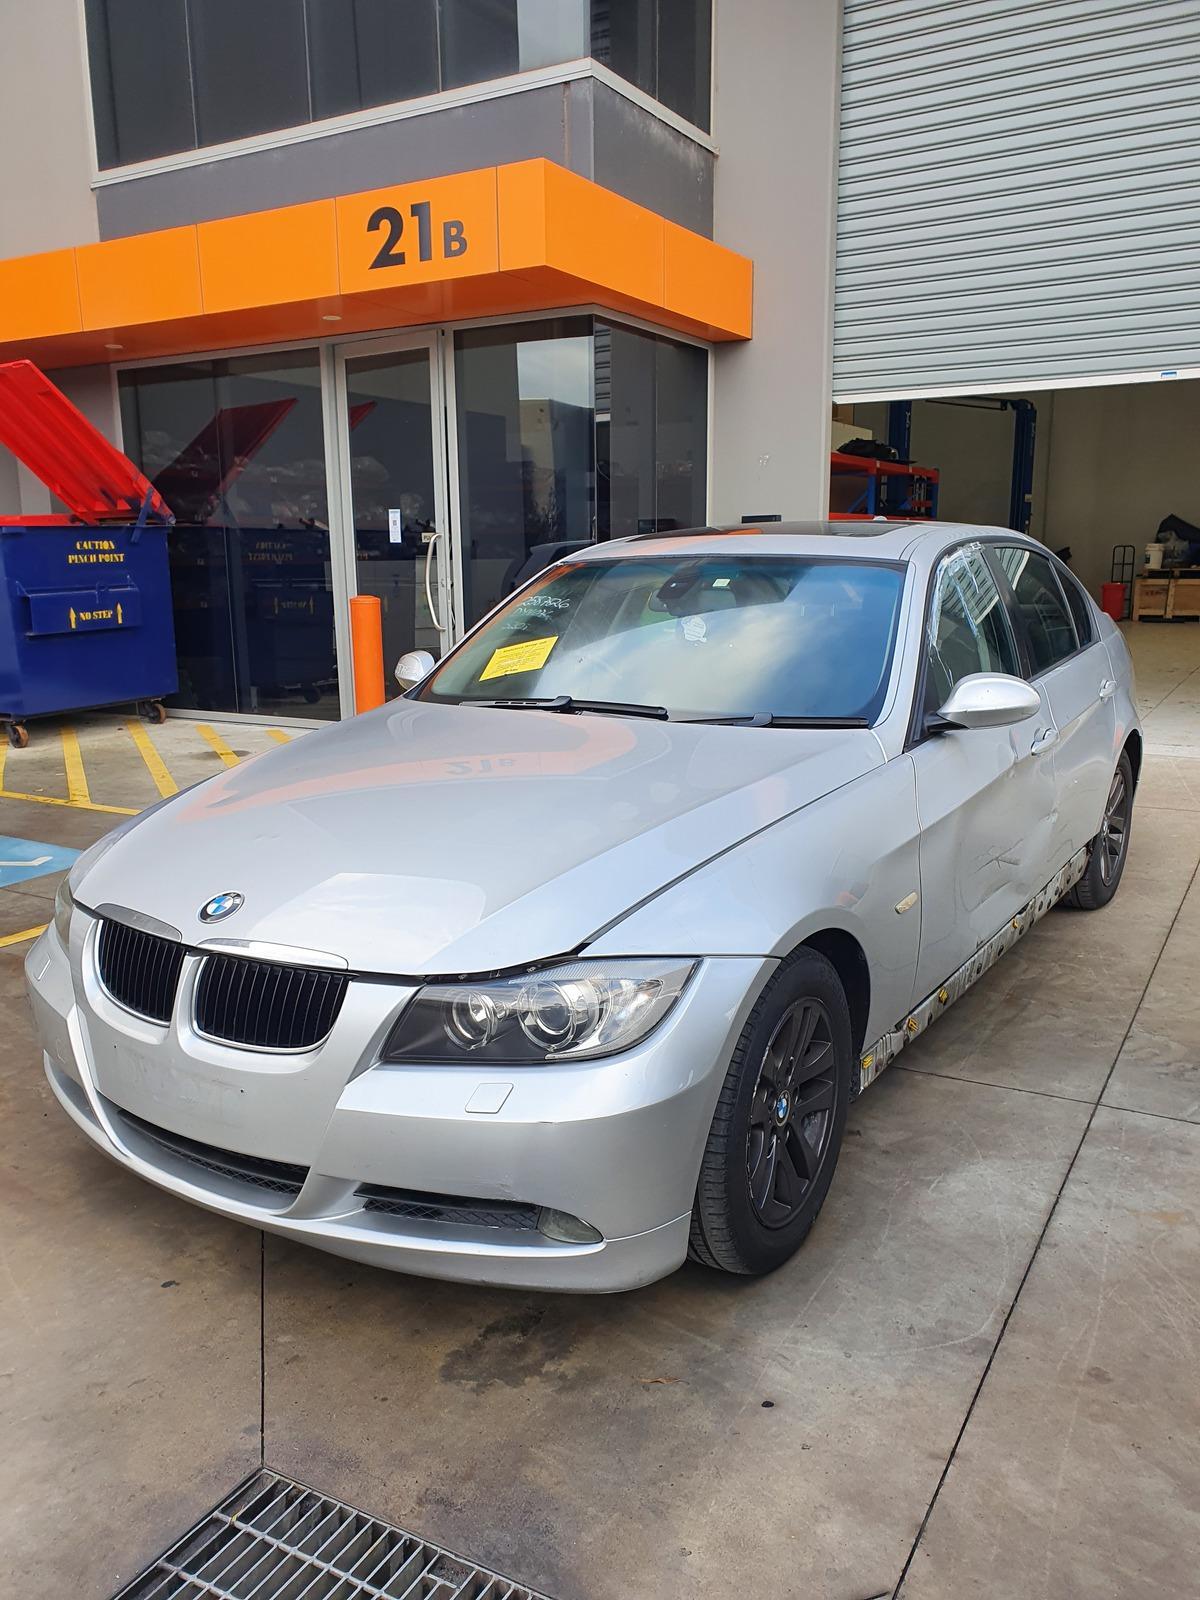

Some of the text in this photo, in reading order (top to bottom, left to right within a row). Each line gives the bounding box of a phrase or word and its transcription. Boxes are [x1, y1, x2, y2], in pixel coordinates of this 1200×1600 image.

[76, 541, 115, 550] CAUTION
[68, 554, 125, 563] PINCH POINT
[79, 610, 113, 621] NO STEP
